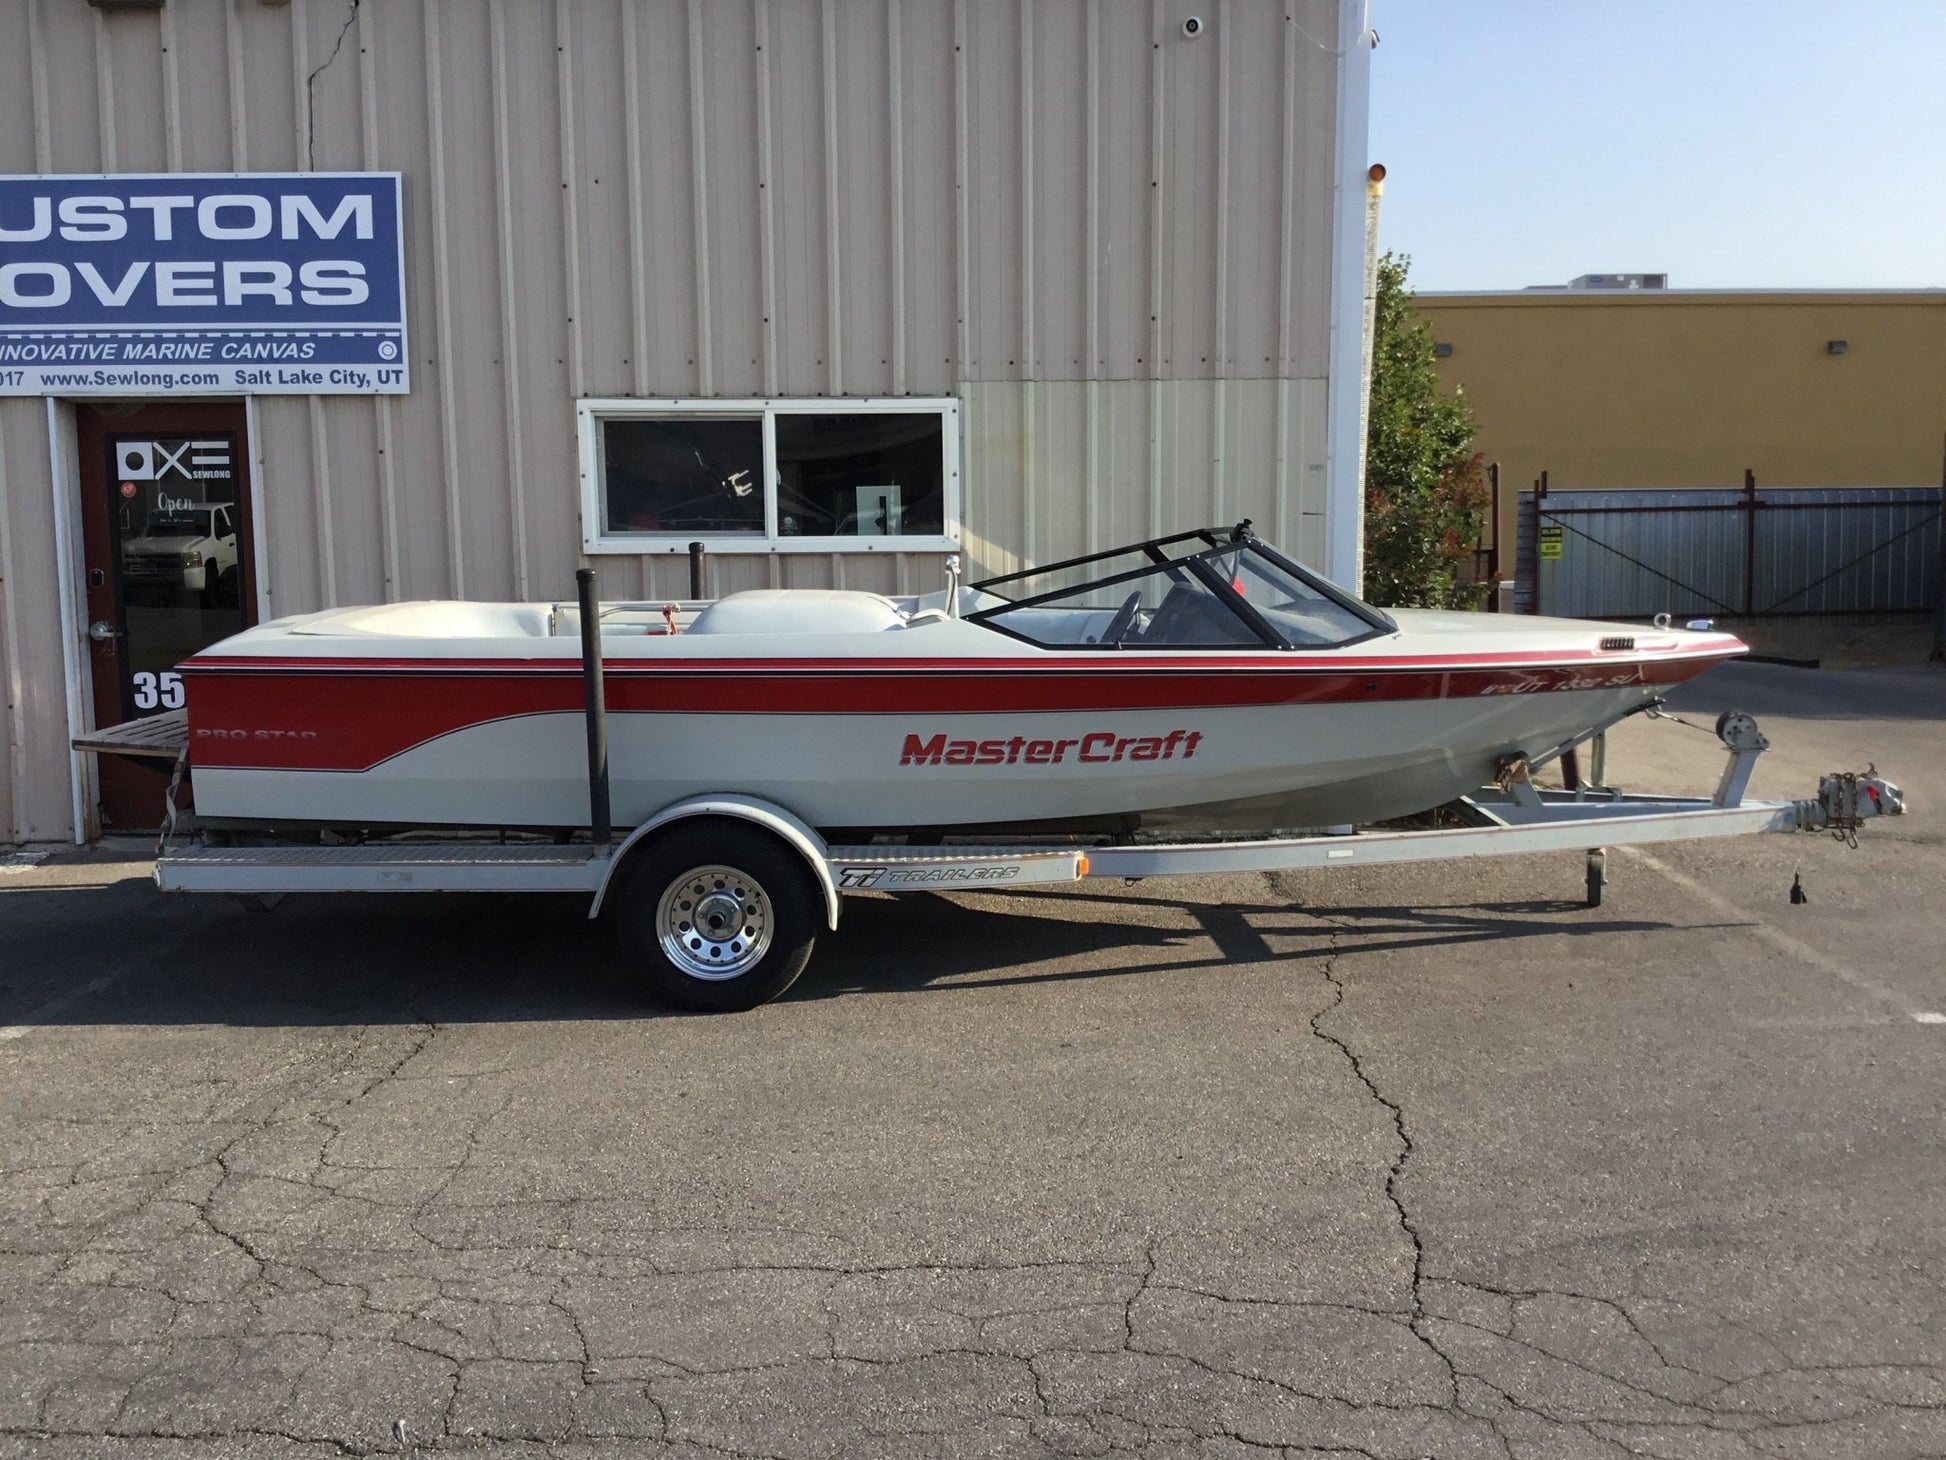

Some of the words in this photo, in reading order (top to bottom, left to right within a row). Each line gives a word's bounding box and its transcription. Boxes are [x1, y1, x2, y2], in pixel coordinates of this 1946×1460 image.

[0, 260, 370, 307] OVERS
[123, 343, 213, 360] MARINE
[221, 342, 316, 359] CANVAS
[40, 370, 220, 389] www.Sewlong.com
[235, 370, 273, 386] Salt
[278, 370, 323, 385] Lake
[329, 369, 371, 388] City,
[377, 370, 404, 385] UT
[193, 470, 231, 479] SEWLONG
[158, 492, 195, 517] Open
[196, 729, 248, 740] PRO
[900, 730, 1203, 766] MasterCraft
[889, 866, 1020, 883] TRAILERS
